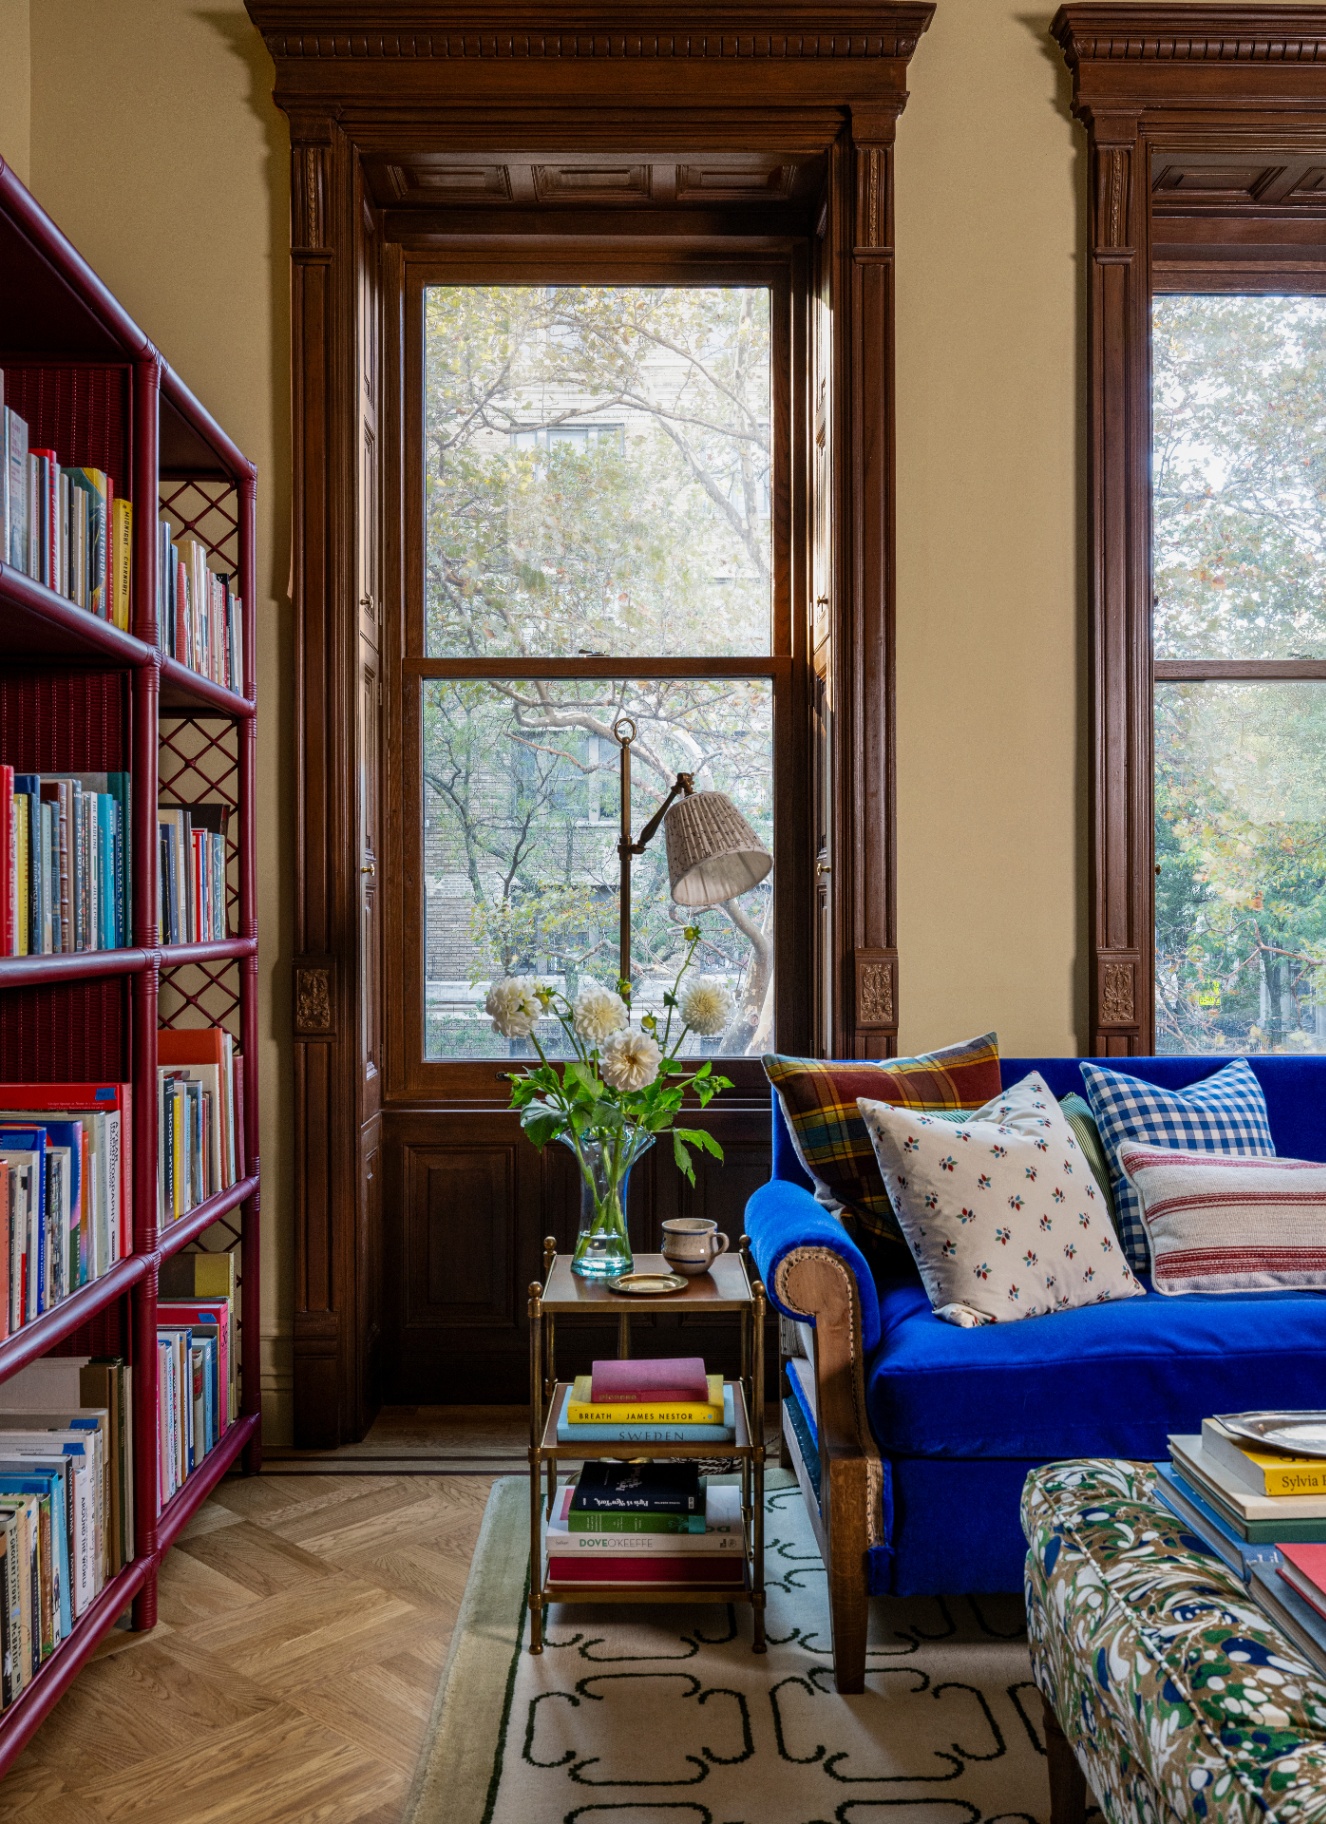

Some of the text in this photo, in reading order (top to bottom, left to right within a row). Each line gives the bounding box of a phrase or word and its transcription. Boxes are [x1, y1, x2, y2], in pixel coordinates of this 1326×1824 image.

[618, 1431, 685, 1441] SWEDEN
[1281, 1475, 1319, 1491] Sylvia
[594, 1498, 612, 1507] York
[633, 1499, 649, 1507] Paris
